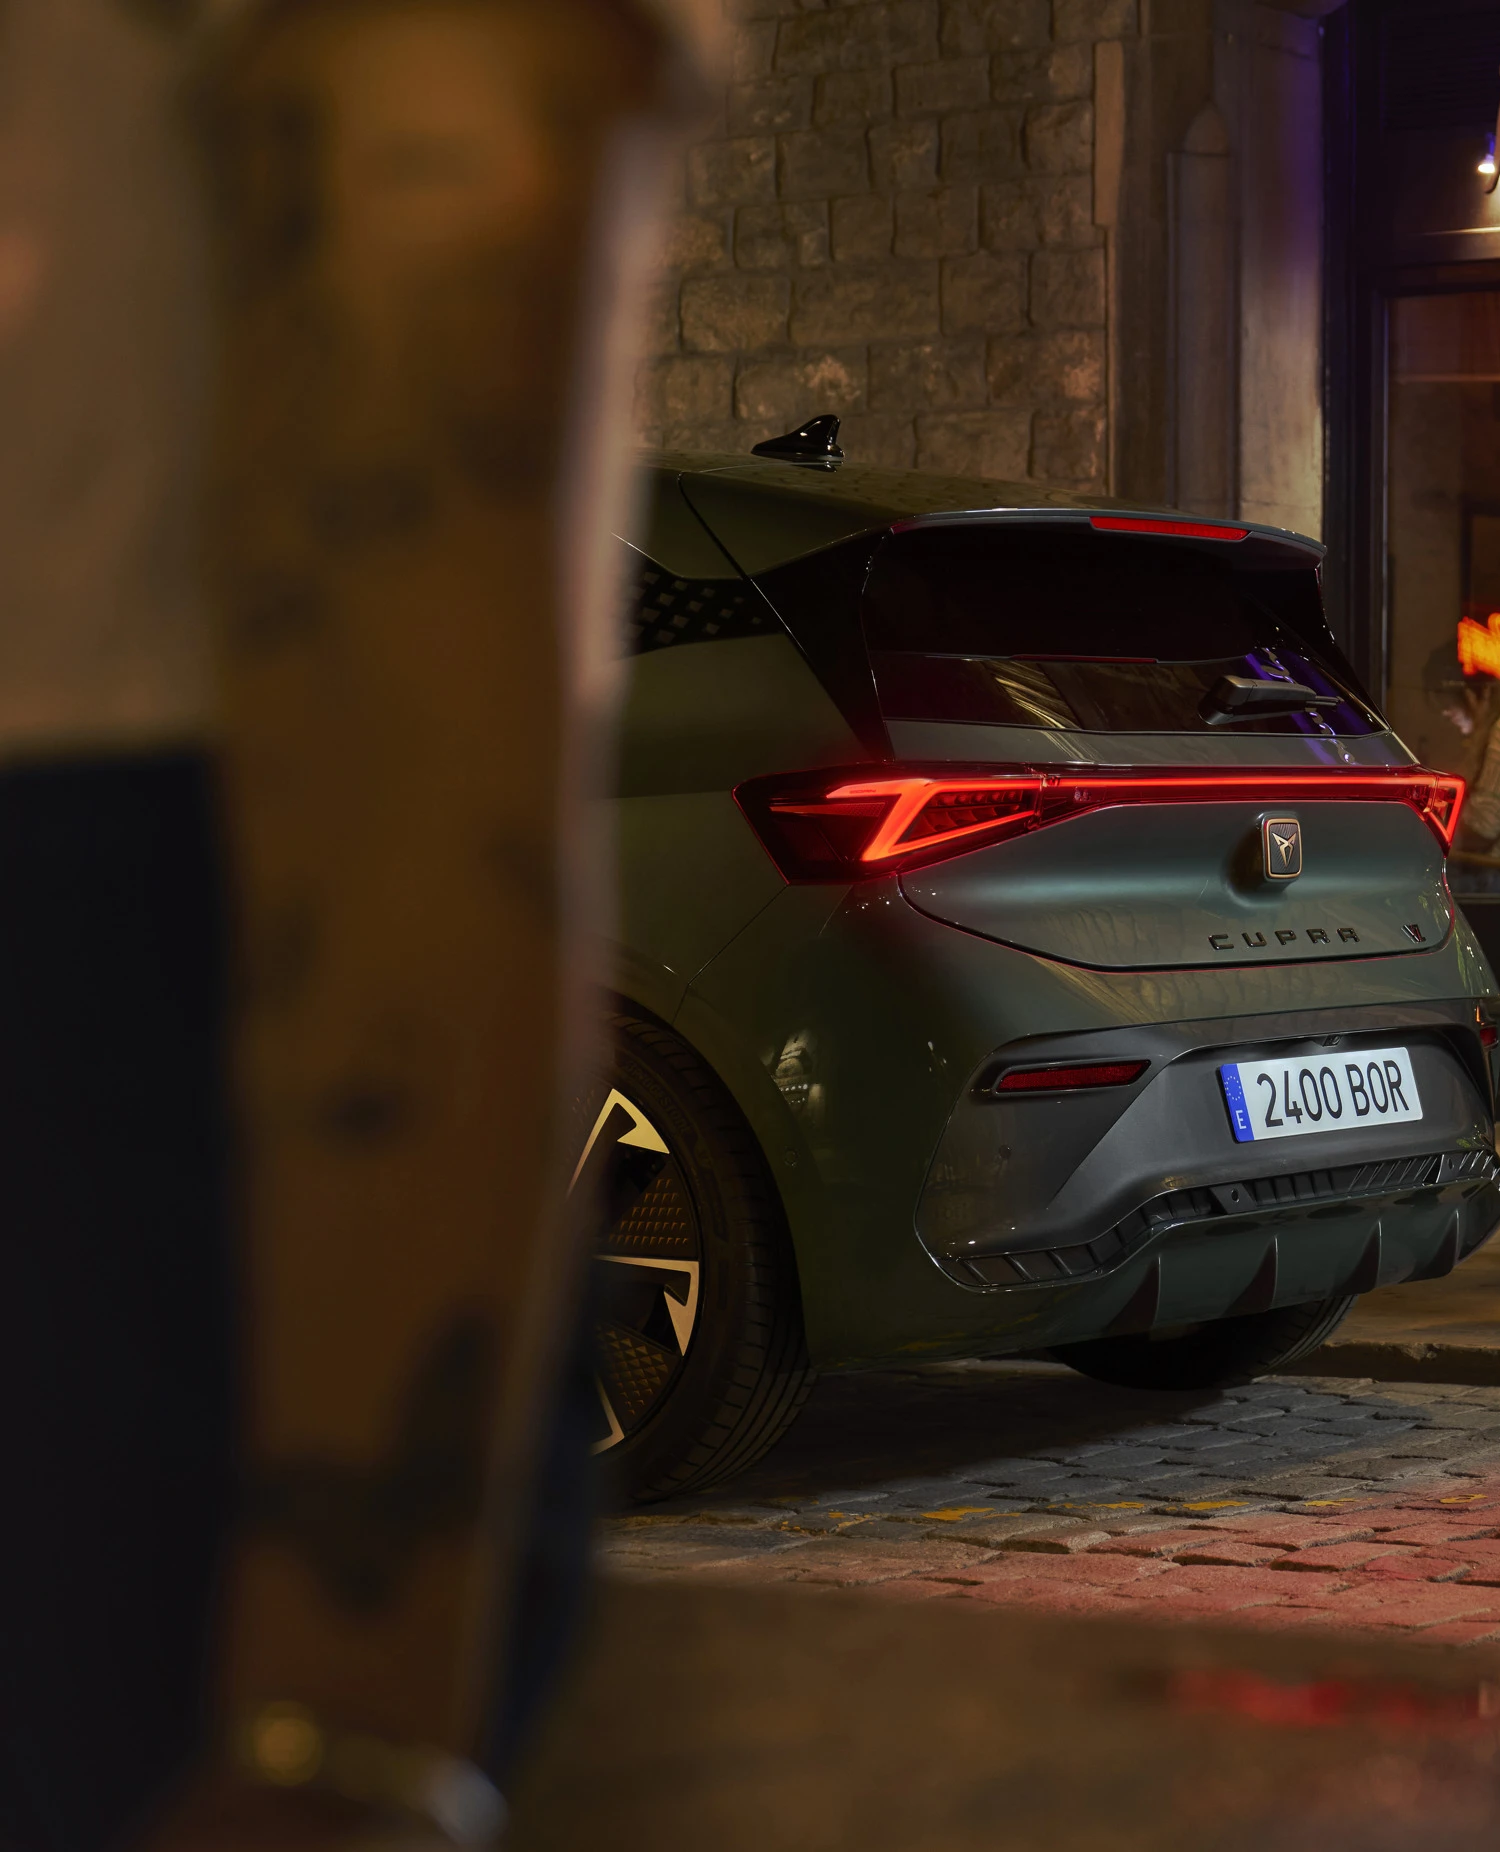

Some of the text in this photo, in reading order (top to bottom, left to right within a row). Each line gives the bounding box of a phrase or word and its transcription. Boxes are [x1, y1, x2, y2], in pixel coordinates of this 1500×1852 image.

[1208, 927, 1360, 950] CUPRA
[1256, 1059, 1410, 1128] 2400 BOR
[1235, 1109, 1247, 1130] E
